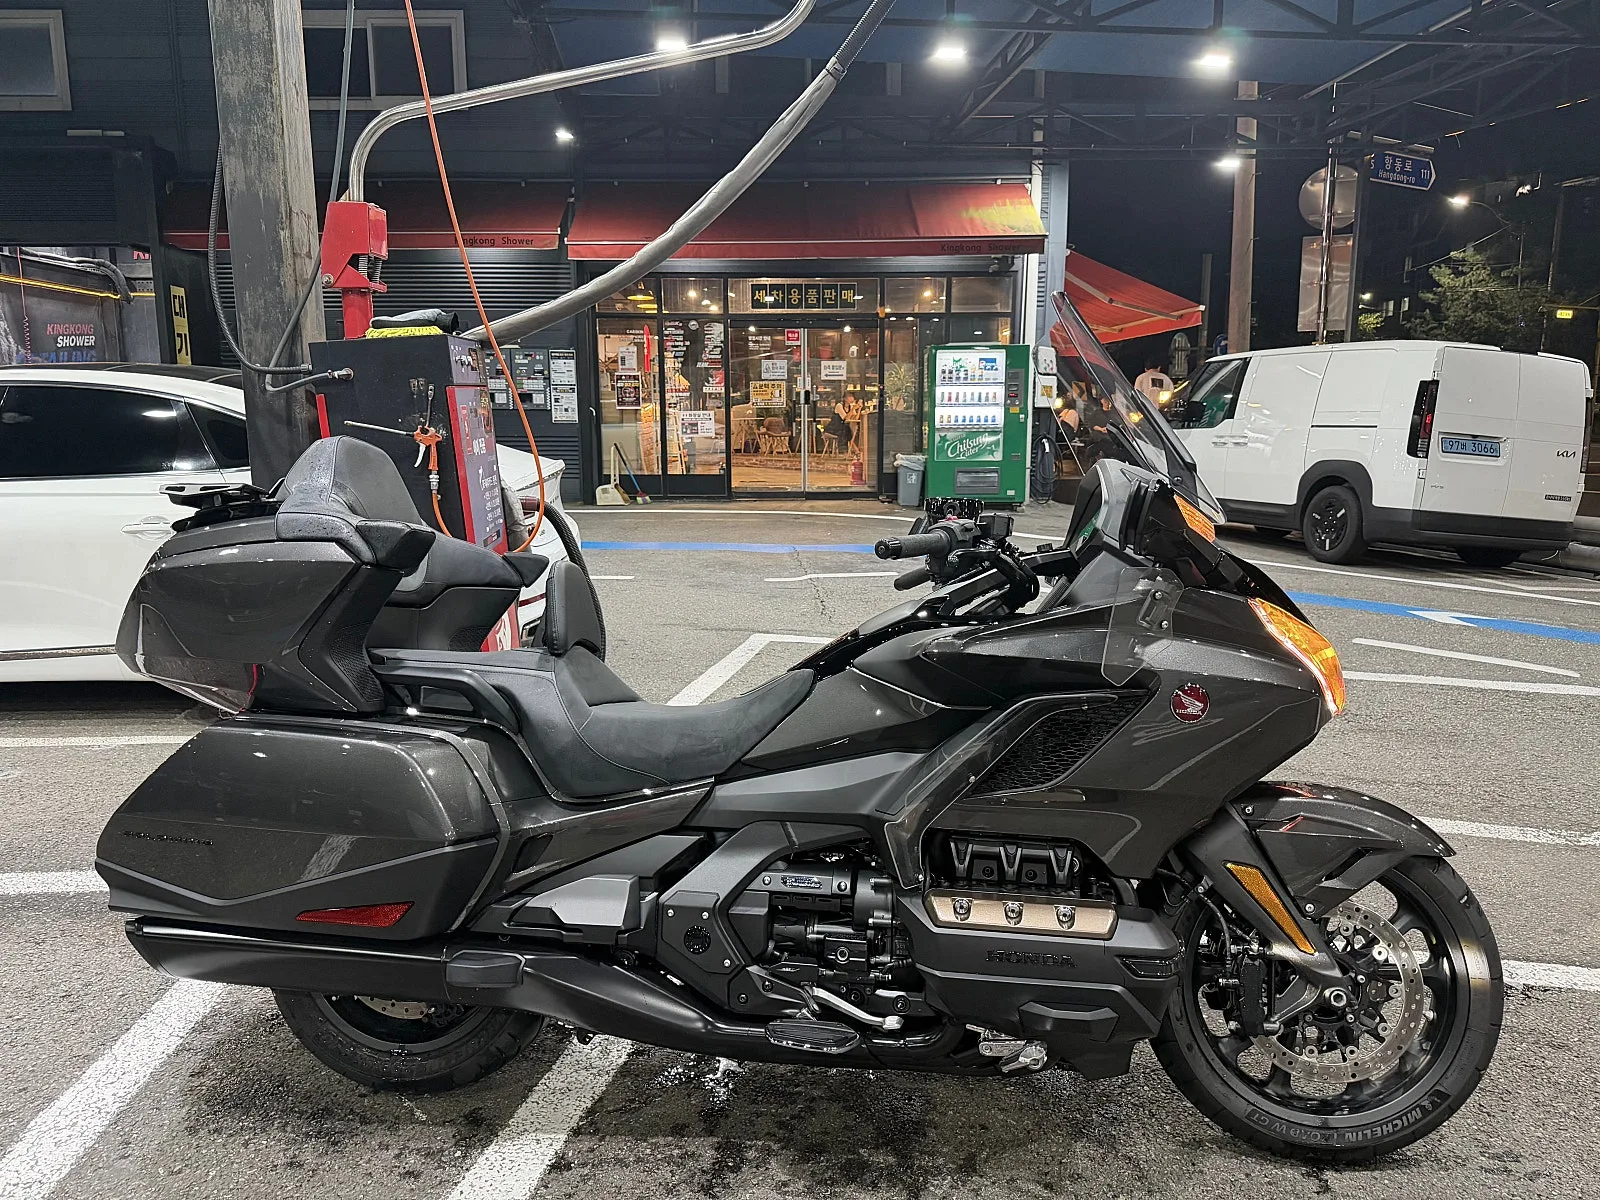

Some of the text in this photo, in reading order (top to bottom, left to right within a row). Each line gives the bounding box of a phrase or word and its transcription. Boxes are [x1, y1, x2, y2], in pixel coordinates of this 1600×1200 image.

[1384, 155, 1413, 172] 항동로
[1378, 168, 1416, 184] Hangdong-ro
[1421, 169, 1430, 180] 111
[454, 236, 534, 246] Kngkong Shower
[940, 243, 981, 253] Kingkong
[753, 288, 855, 305] 세차용품판매
[46, 323, 95, 336] KINGKONG
[172, 294, 189, 357] 대기
[56, 335, 96, 348] SHOWER
[945, 433, 988, 458] Chilsung
[1448, 440, 1496, 454] 97버 3066
[1556, 450, 1576, 458] KIA
[986, 949, 1078, 968] HONDA
[1343, 1108, 1423, 1142] MICHELIN
